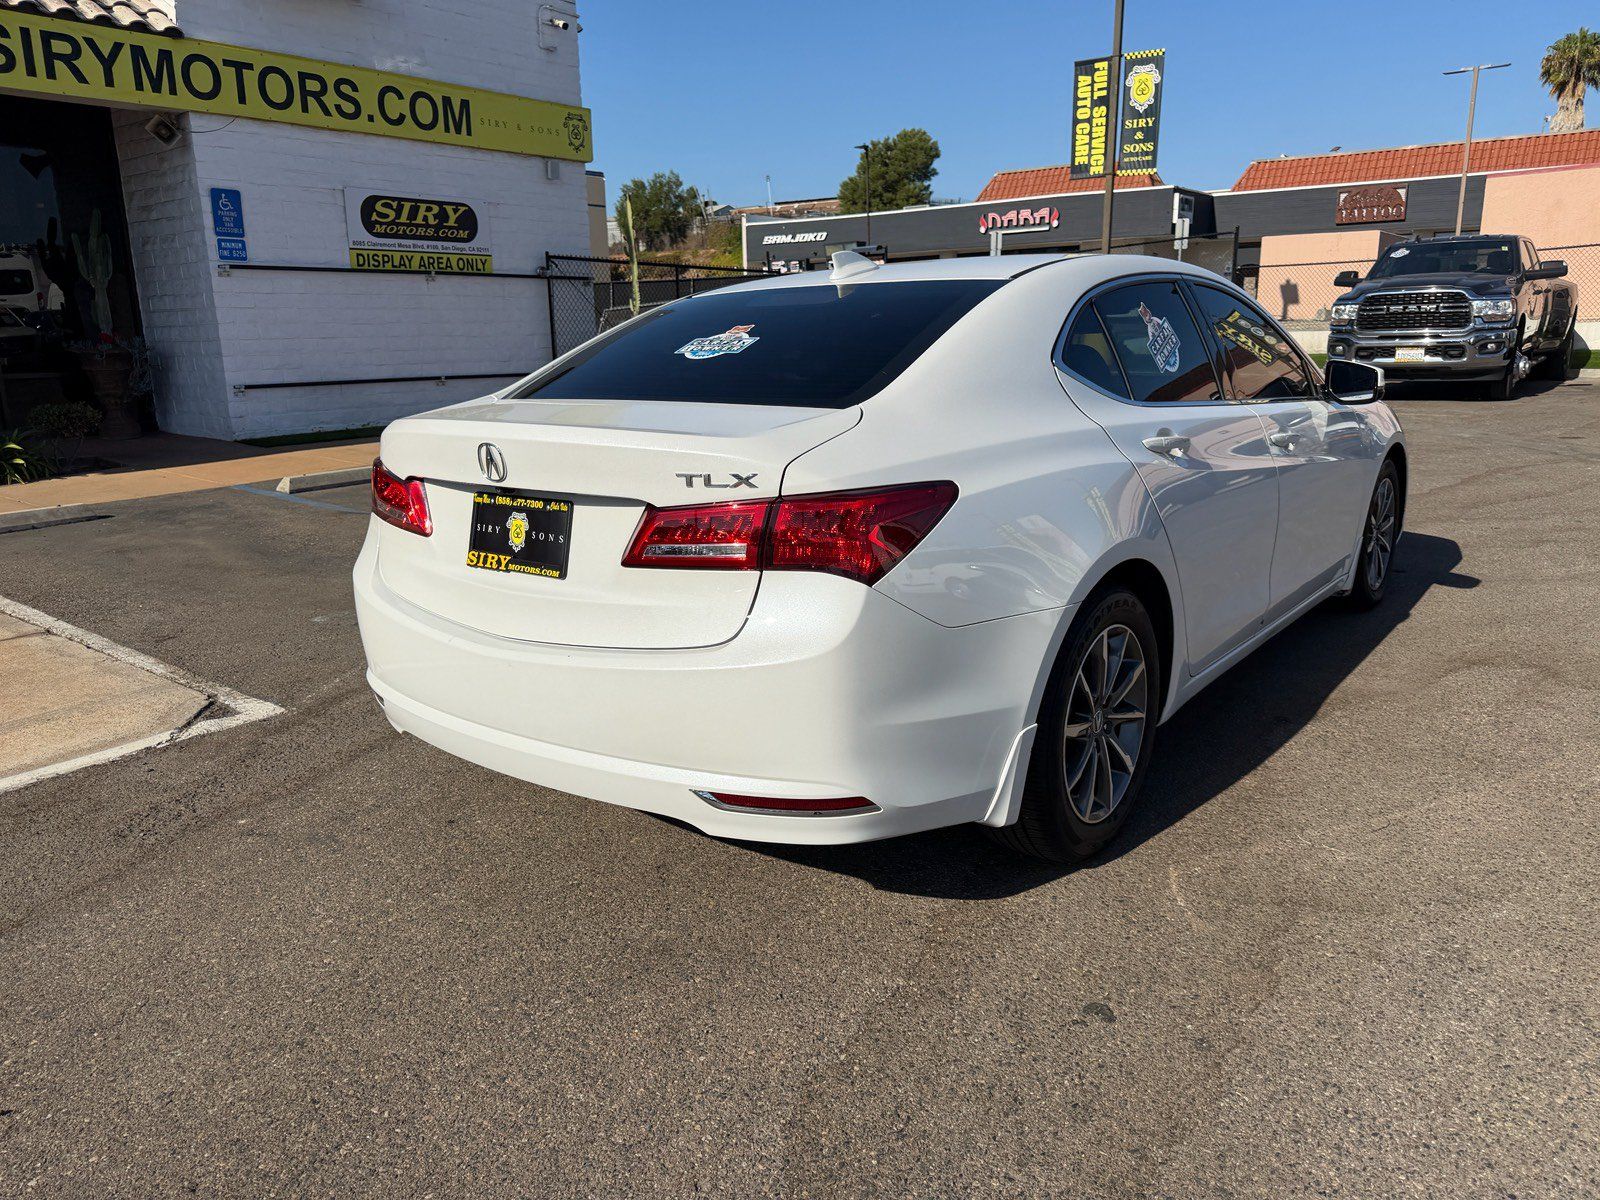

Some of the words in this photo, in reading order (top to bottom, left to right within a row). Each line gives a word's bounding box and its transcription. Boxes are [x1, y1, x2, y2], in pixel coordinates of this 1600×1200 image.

[1093, 61, 1109, 100] FULL
[1076, 75, 1092, 120] AUTO
[480, 117, 508, 129] SIRY
[530, 125, 560, 137] SONS
[1124, 117, 1155, 129] SIRY
[1075, 122, 1090, 166] CARE
[1089, 105, 1107, 176] SERVICE
[1134, 131, 1144, 140] &
[1123, 142, 1154, 154] SONS
[371, 199, 469, 227] SIRY
[987, 207, 1050, 229] NARA
[372, 224, 470, 239] MOTORS.COM
[762, 231, 828, 245] SAMJOKO
[356, 253, 414, 269] DISPLAY
[418, 256, 453, 271] AREA
[456, 257, 488, 272] ONLY
[675, 473, 759, 489] TLX
[476, 523, 501, 534] SIRY
[531, 531, 564, 543] SONS
[466, 550, 512, 571] SIRY
[508, 563, 560, 578] MOTORS.COM
